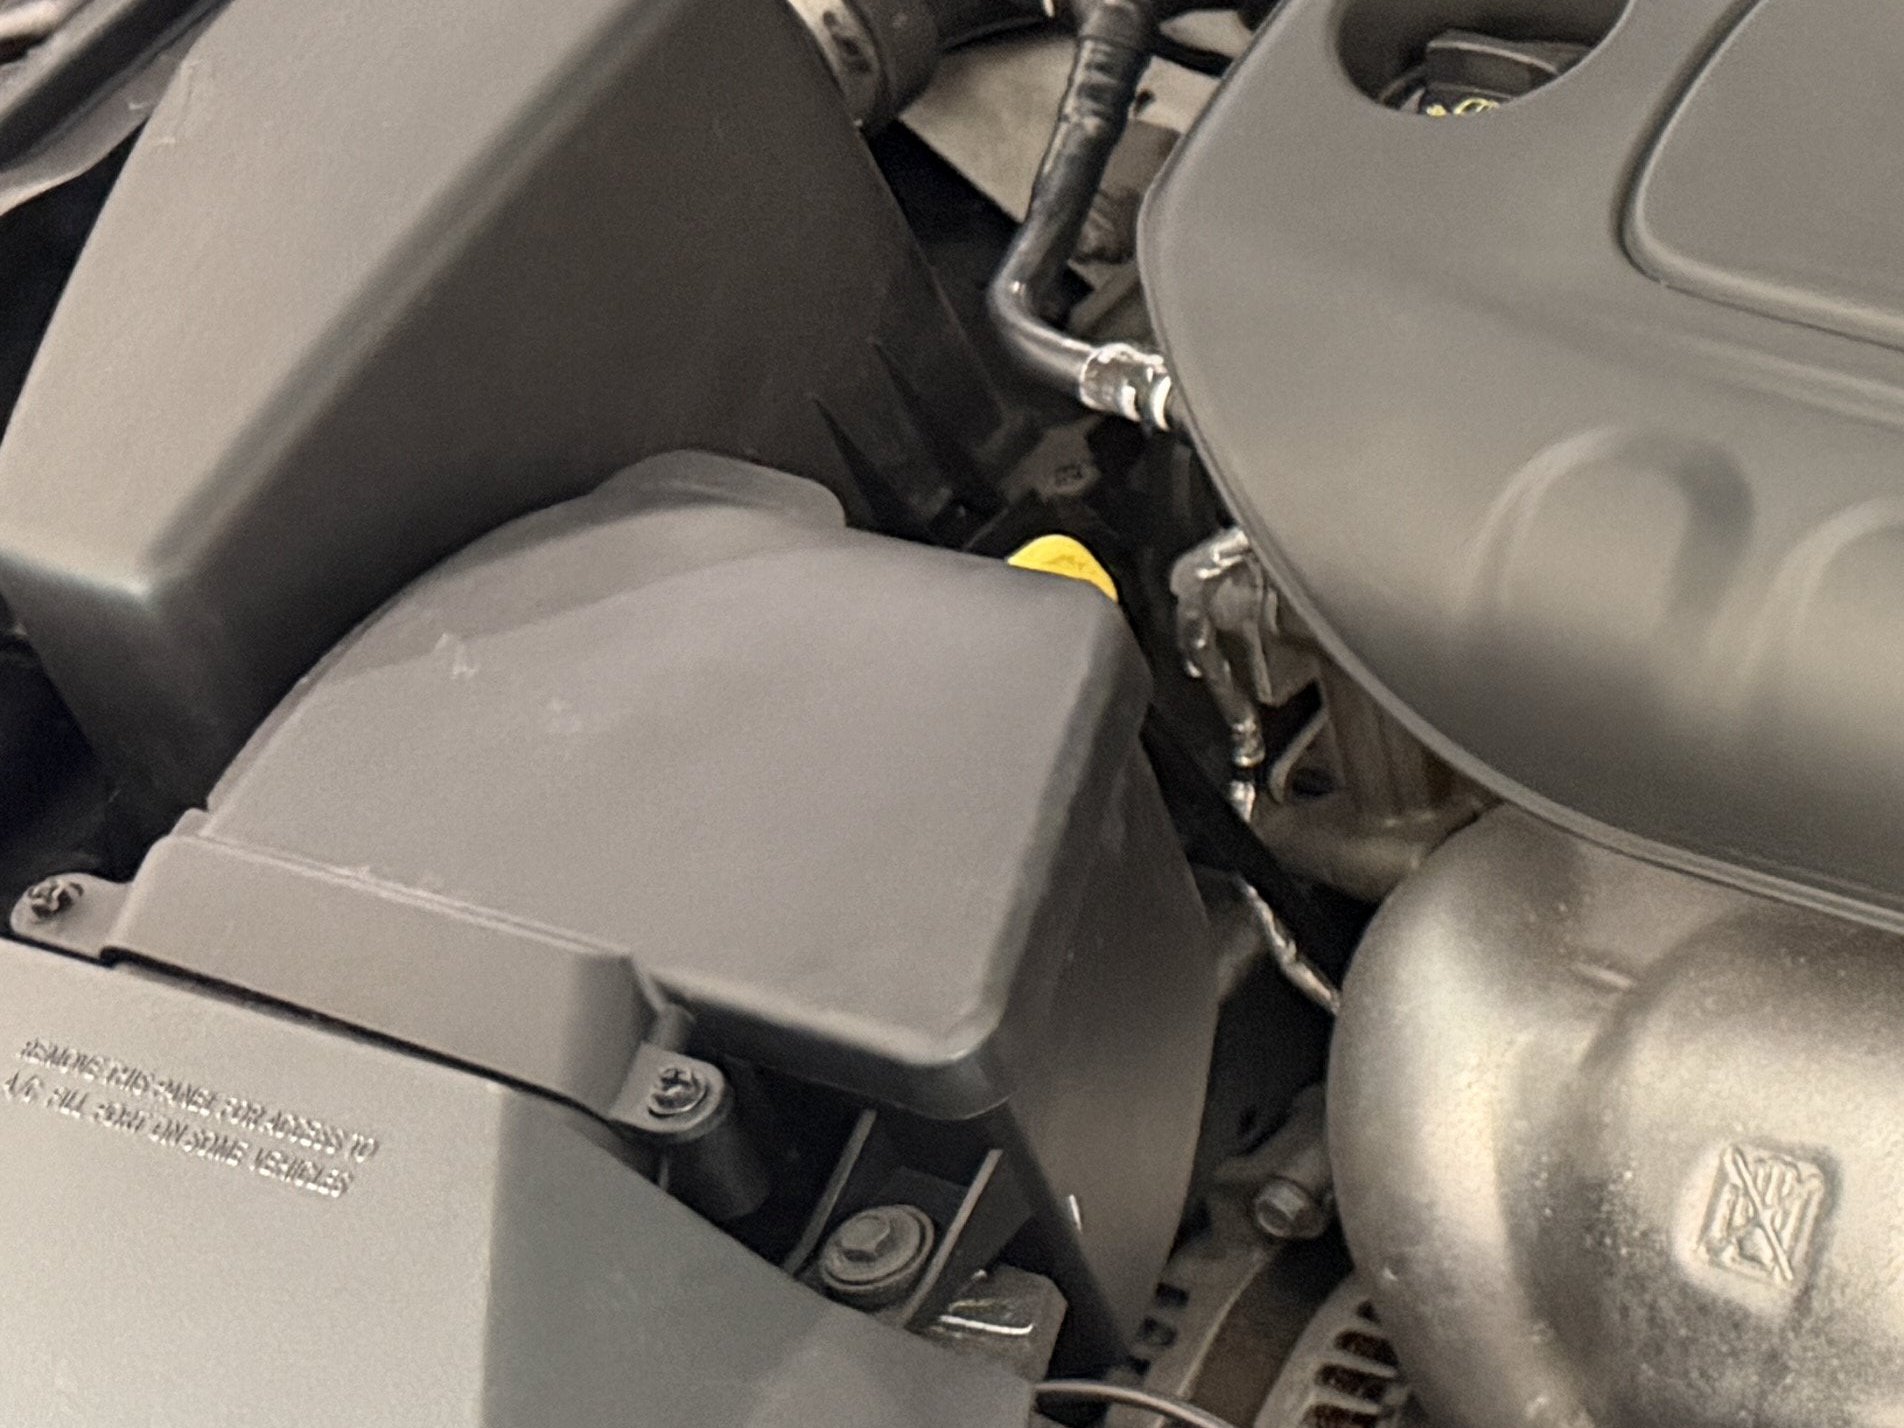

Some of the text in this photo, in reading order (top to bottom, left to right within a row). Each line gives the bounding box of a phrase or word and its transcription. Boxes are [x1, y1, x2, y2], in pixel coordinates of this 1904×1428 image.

[264, 1110, 347, 1155] ACCESS
[180, 1127, 250, 1168] SOME
[249, 1148, 355, 1198] VEHICLES
